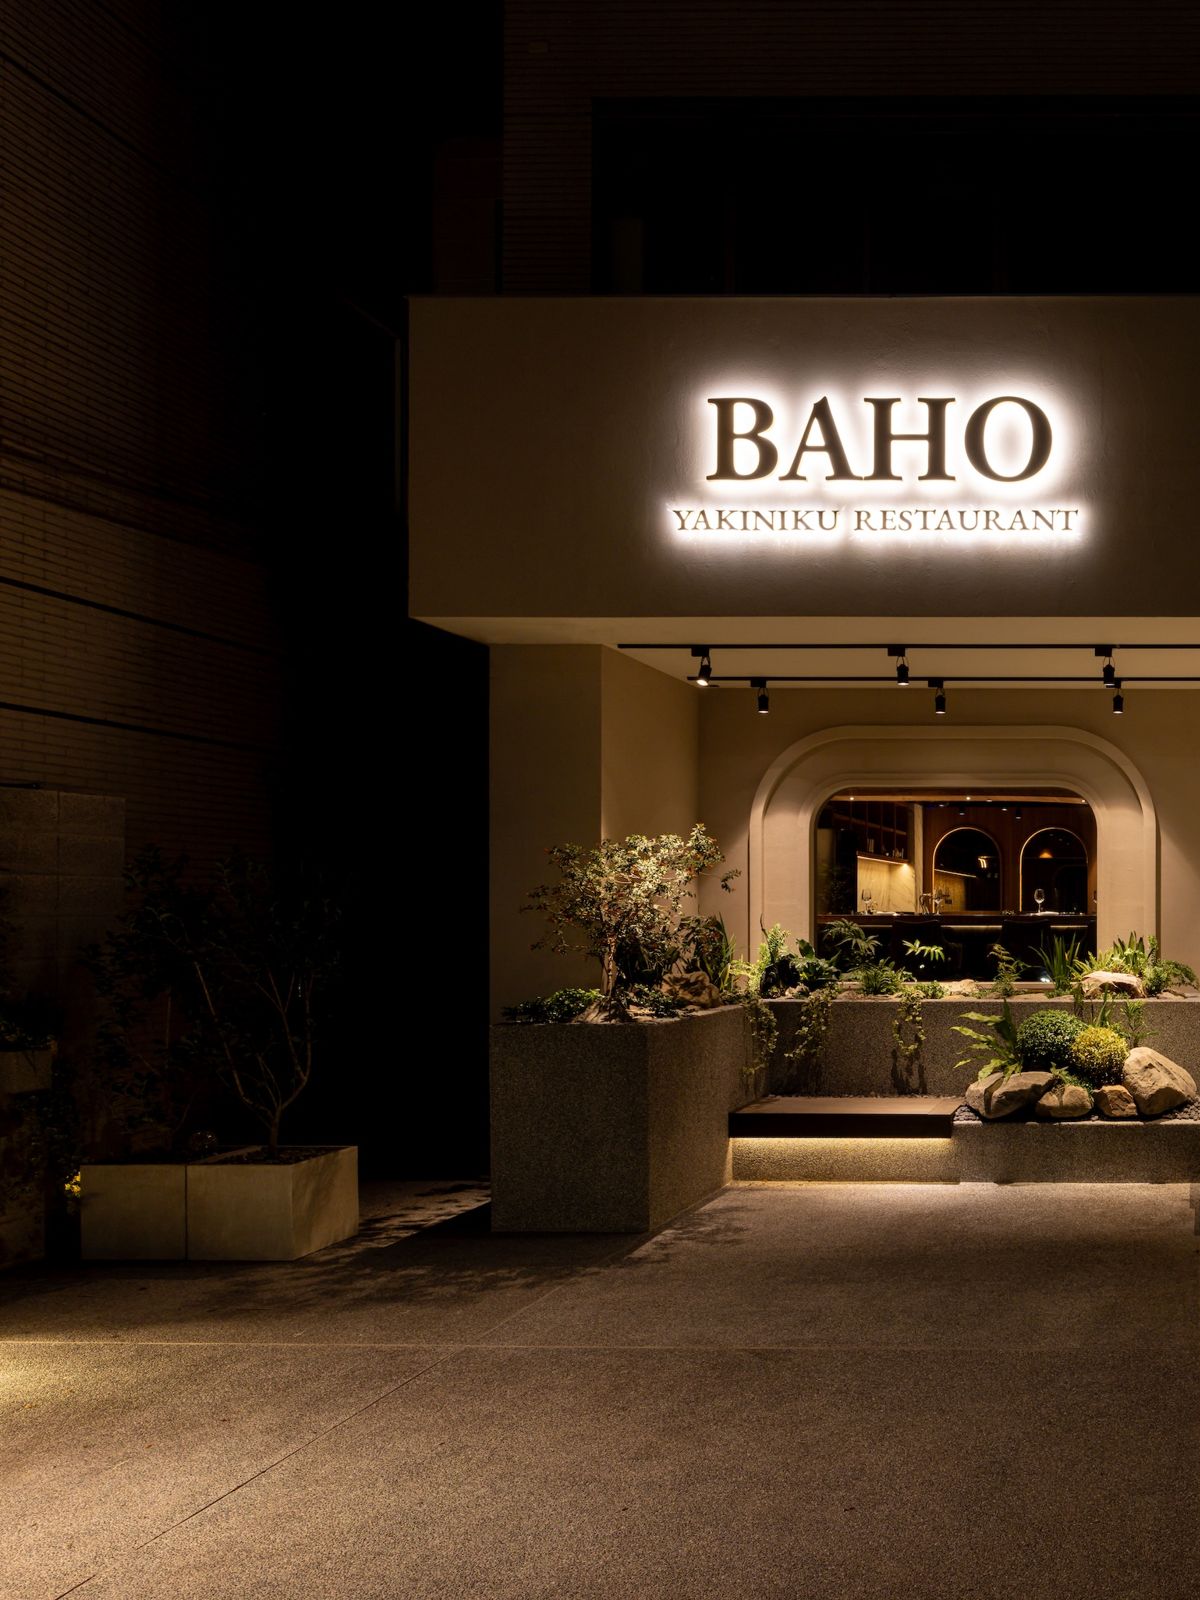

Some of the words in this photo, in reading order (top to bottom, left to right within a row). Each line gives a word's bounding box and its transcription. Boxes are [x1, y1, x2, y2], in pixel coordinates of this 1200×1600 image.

[706, 396, 1053, 482] BAHO
[673, 509, 839, 532] YAKINIKU
[853, 509, 1079, 532] RESTAURANT
